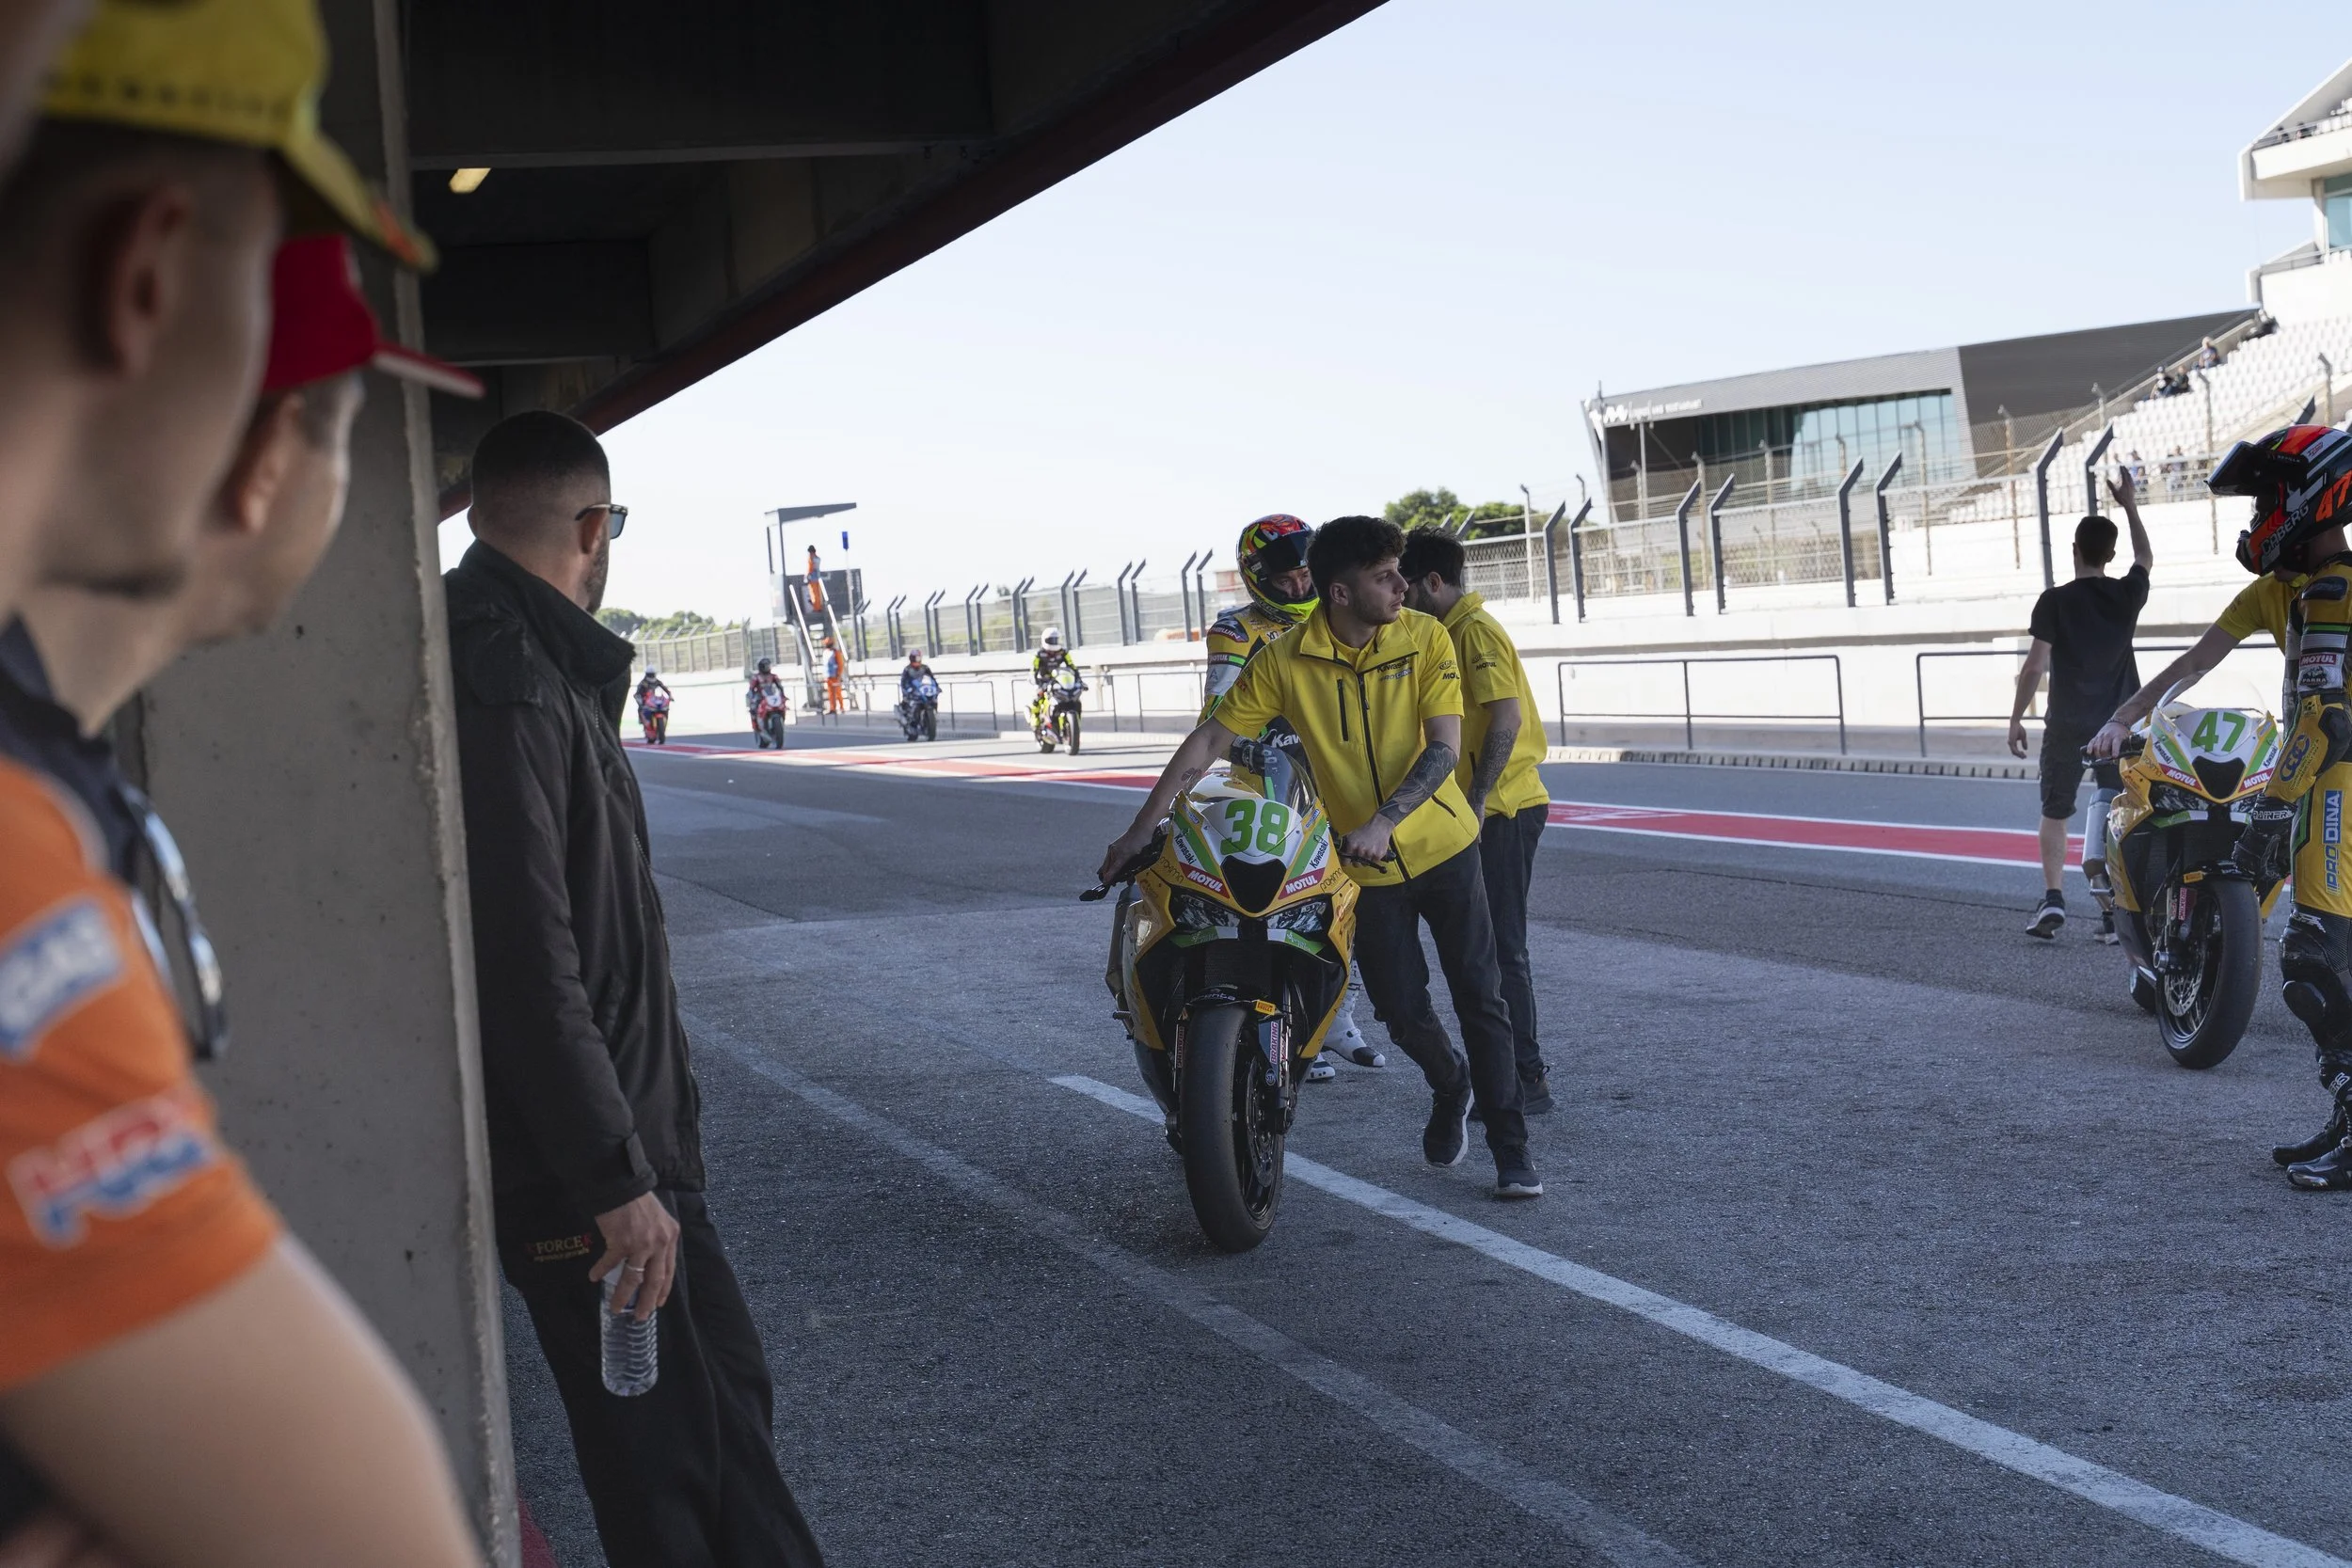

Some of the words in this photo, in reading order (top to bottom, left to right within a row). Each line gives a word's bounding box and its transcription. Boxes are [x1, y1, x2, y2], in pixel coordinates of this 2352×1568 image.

[2261, 499, 2310, 554] CABERG
[2301, 655, 2334, 664] MOTUL
[2190, 711, 2247, 753] 47
[2153, 741, 2174, 765] Kawasaki
[2264, 745, 2279, 768] Kawasaki
[2166, 768, 2198, 787] MOTUL
[2243, 772, 2270, 788] MOTUL
[1220, 800, 1290, 857] 38
[1174, 832, 1197, 864] Kawasaki
[1310, 838, 1329, 868] Kawasaki
[1187, 870, 1223, 893] MOTUL
[1285, 875, 1317, 895] MOTUL
[1271, 1021, 1279, 1065] BRAKING
[535, 1234, 582, 1255] FORCE
